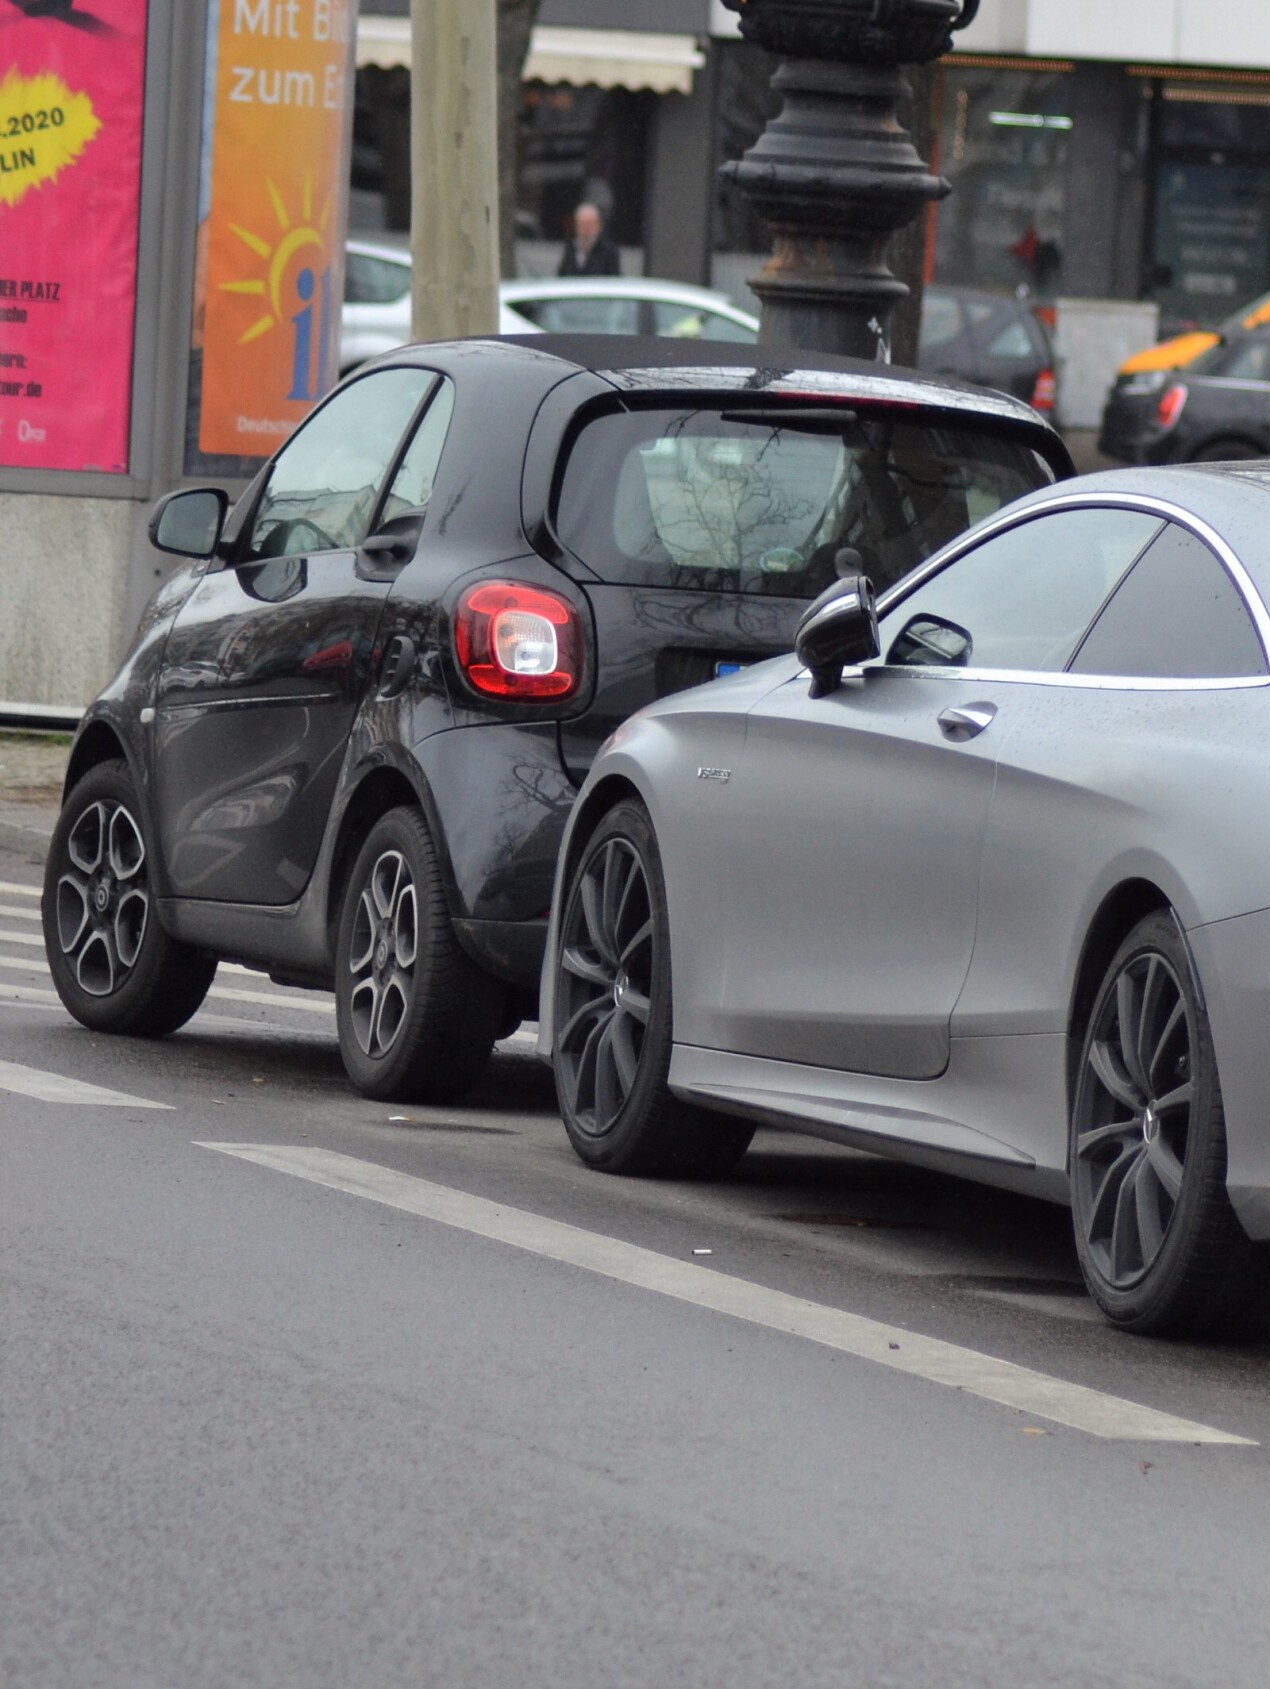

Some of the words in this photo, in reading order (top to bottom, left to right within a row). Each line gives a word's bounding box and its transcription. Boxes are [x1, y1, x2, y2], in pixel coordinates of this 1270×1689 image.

[233, 0, 299, 38] Mit
[230, 66, 314, 107] zum
[323, 64, 345, 110] E
[21, 281, 61, 301] PLATZ
